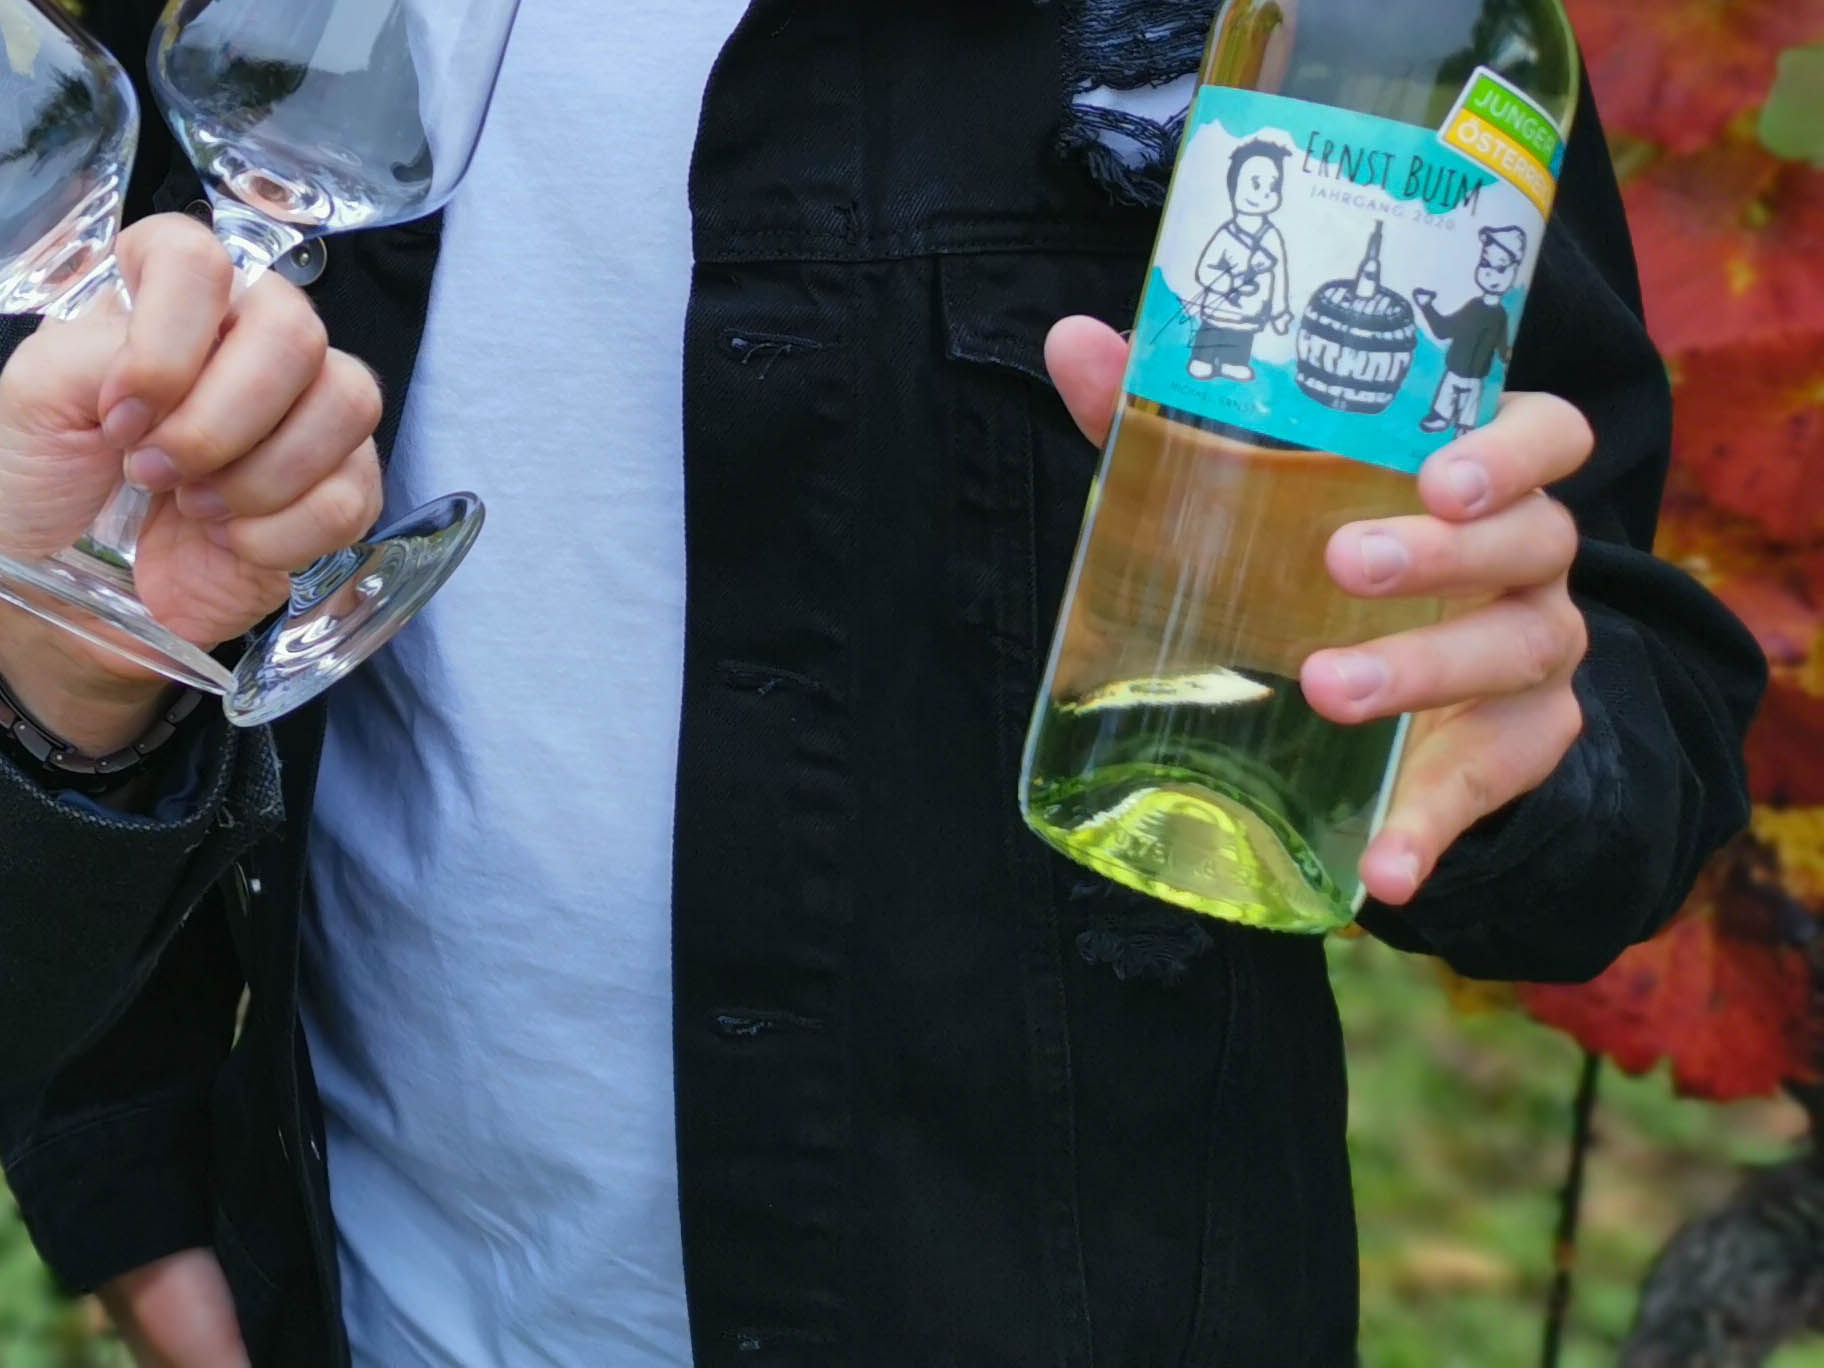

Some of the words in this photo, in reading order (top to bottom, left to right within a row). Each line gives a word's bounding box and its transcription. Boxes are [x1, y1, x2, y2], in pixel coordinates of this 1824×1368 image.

[1474, 90, 1554, 154] JUNGER
[1302, 131, 1395, 190] ERNST
[1404, 155, 1483, 217] BUIM
[1310, 185, 1403, 218] JAHRGANG
[1412, 209, 1456, 231] 2020
